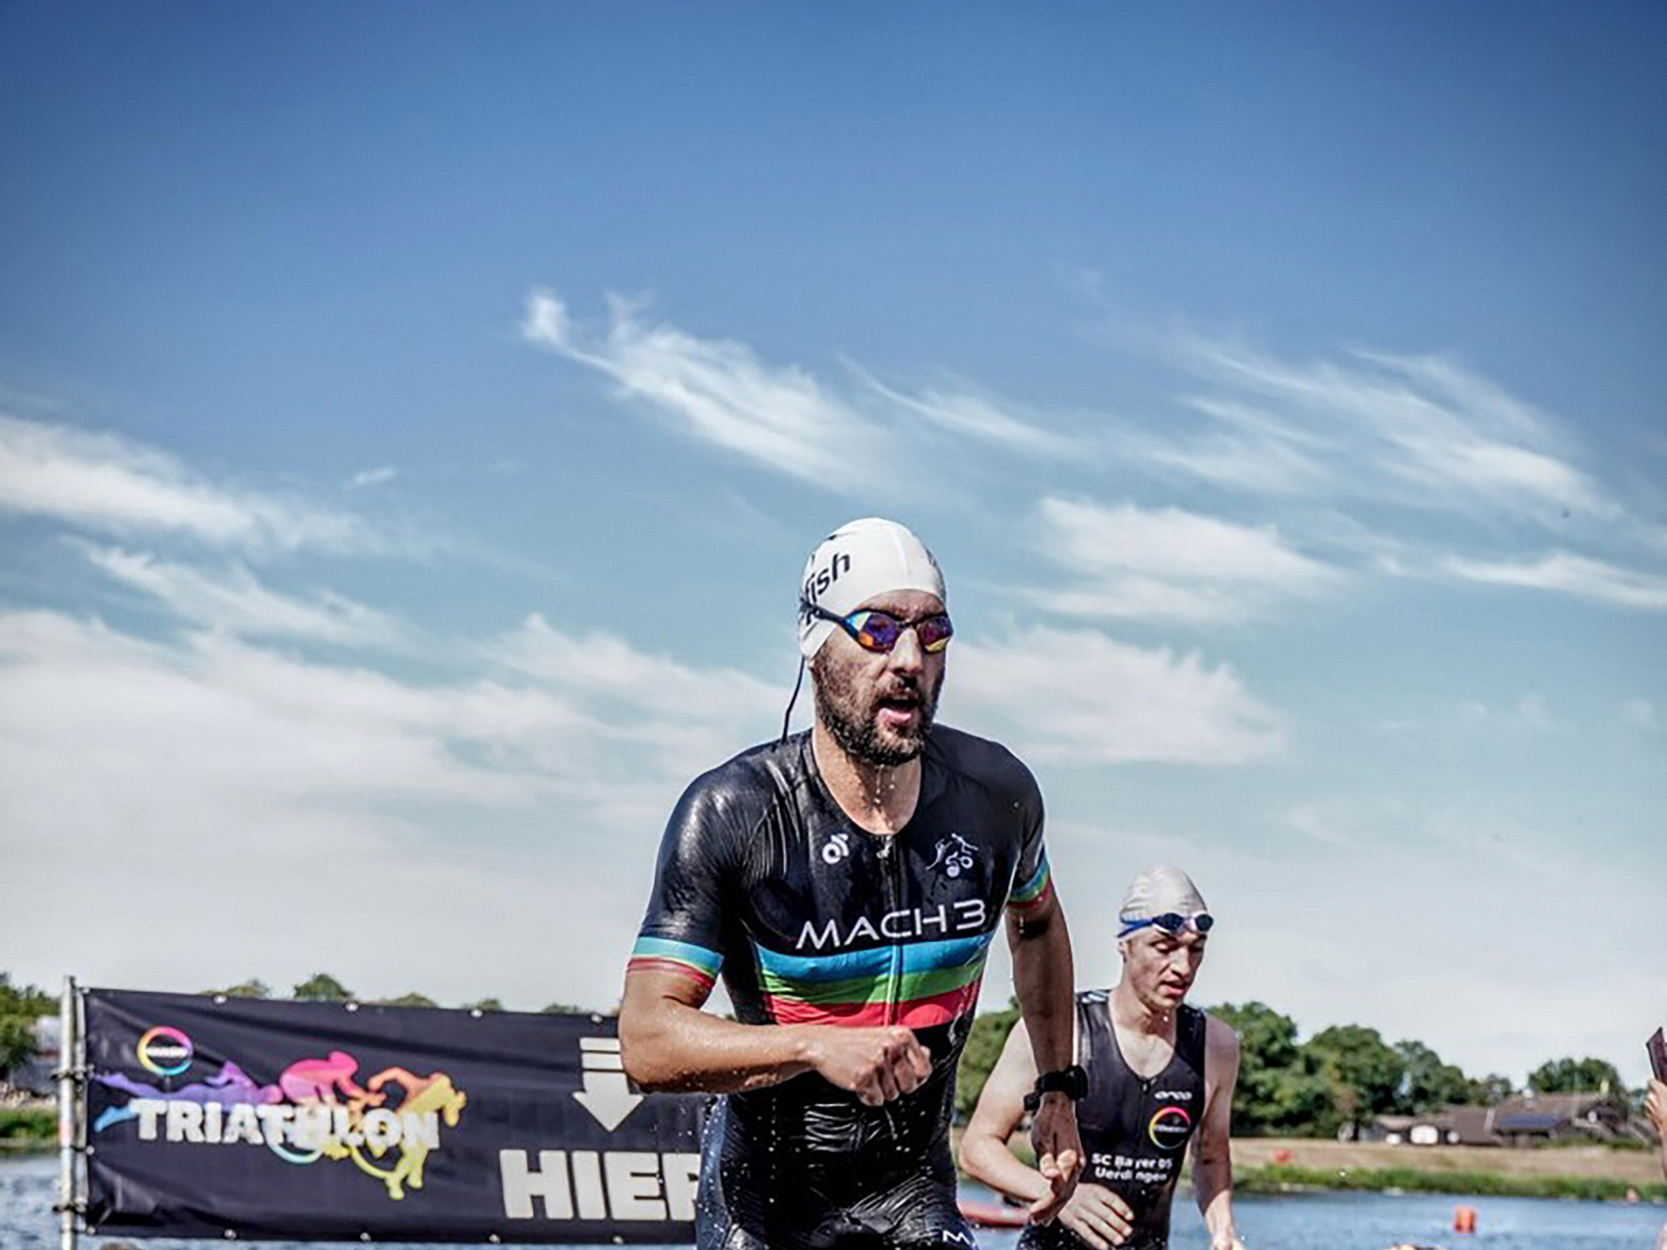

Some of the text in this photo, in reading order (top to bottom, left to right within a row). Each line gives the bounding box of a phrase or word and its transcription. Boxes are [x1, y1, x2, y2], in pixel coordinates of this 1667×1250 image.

[129, 1098, 440, 1150] TRIATHLON
[1091, 1153, 1113, 1166] SC
[1095, 1166, 1168, 1184] Uerdingen
[500, 1149, 701, 1221] HIER
